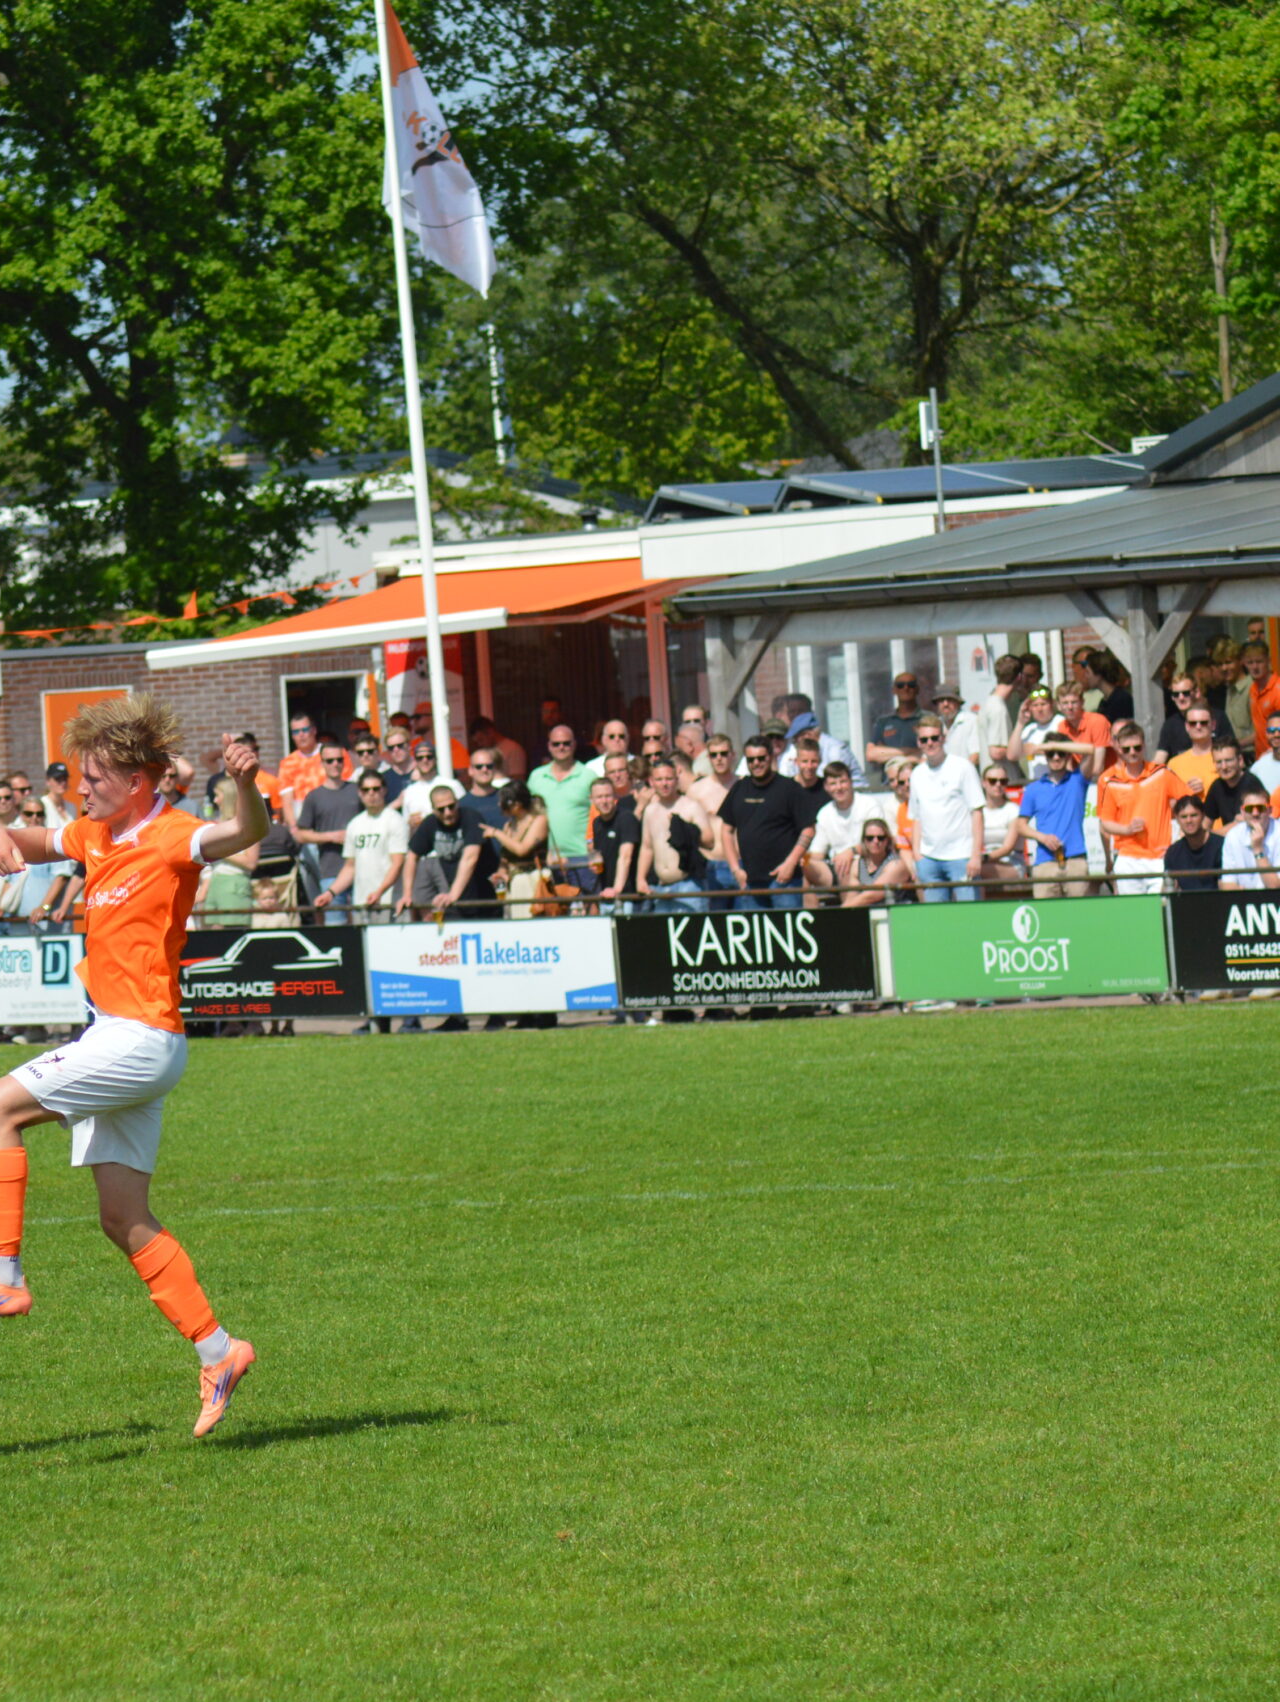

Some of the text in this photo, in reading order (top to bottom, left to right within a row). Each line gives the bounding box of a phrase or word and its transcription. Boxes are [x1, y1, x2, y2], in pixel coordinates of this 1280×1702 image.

[443, 935, 460, 951] elf
[668, 911, 819, 967] KARINS
[419, 952, 460, 967] steden
[673, 969, 820, 992] SCHOONHEIDSSALON
[226, 1004, 240, 1014] DE
[243, 1003, 272, 1013] VRIES
